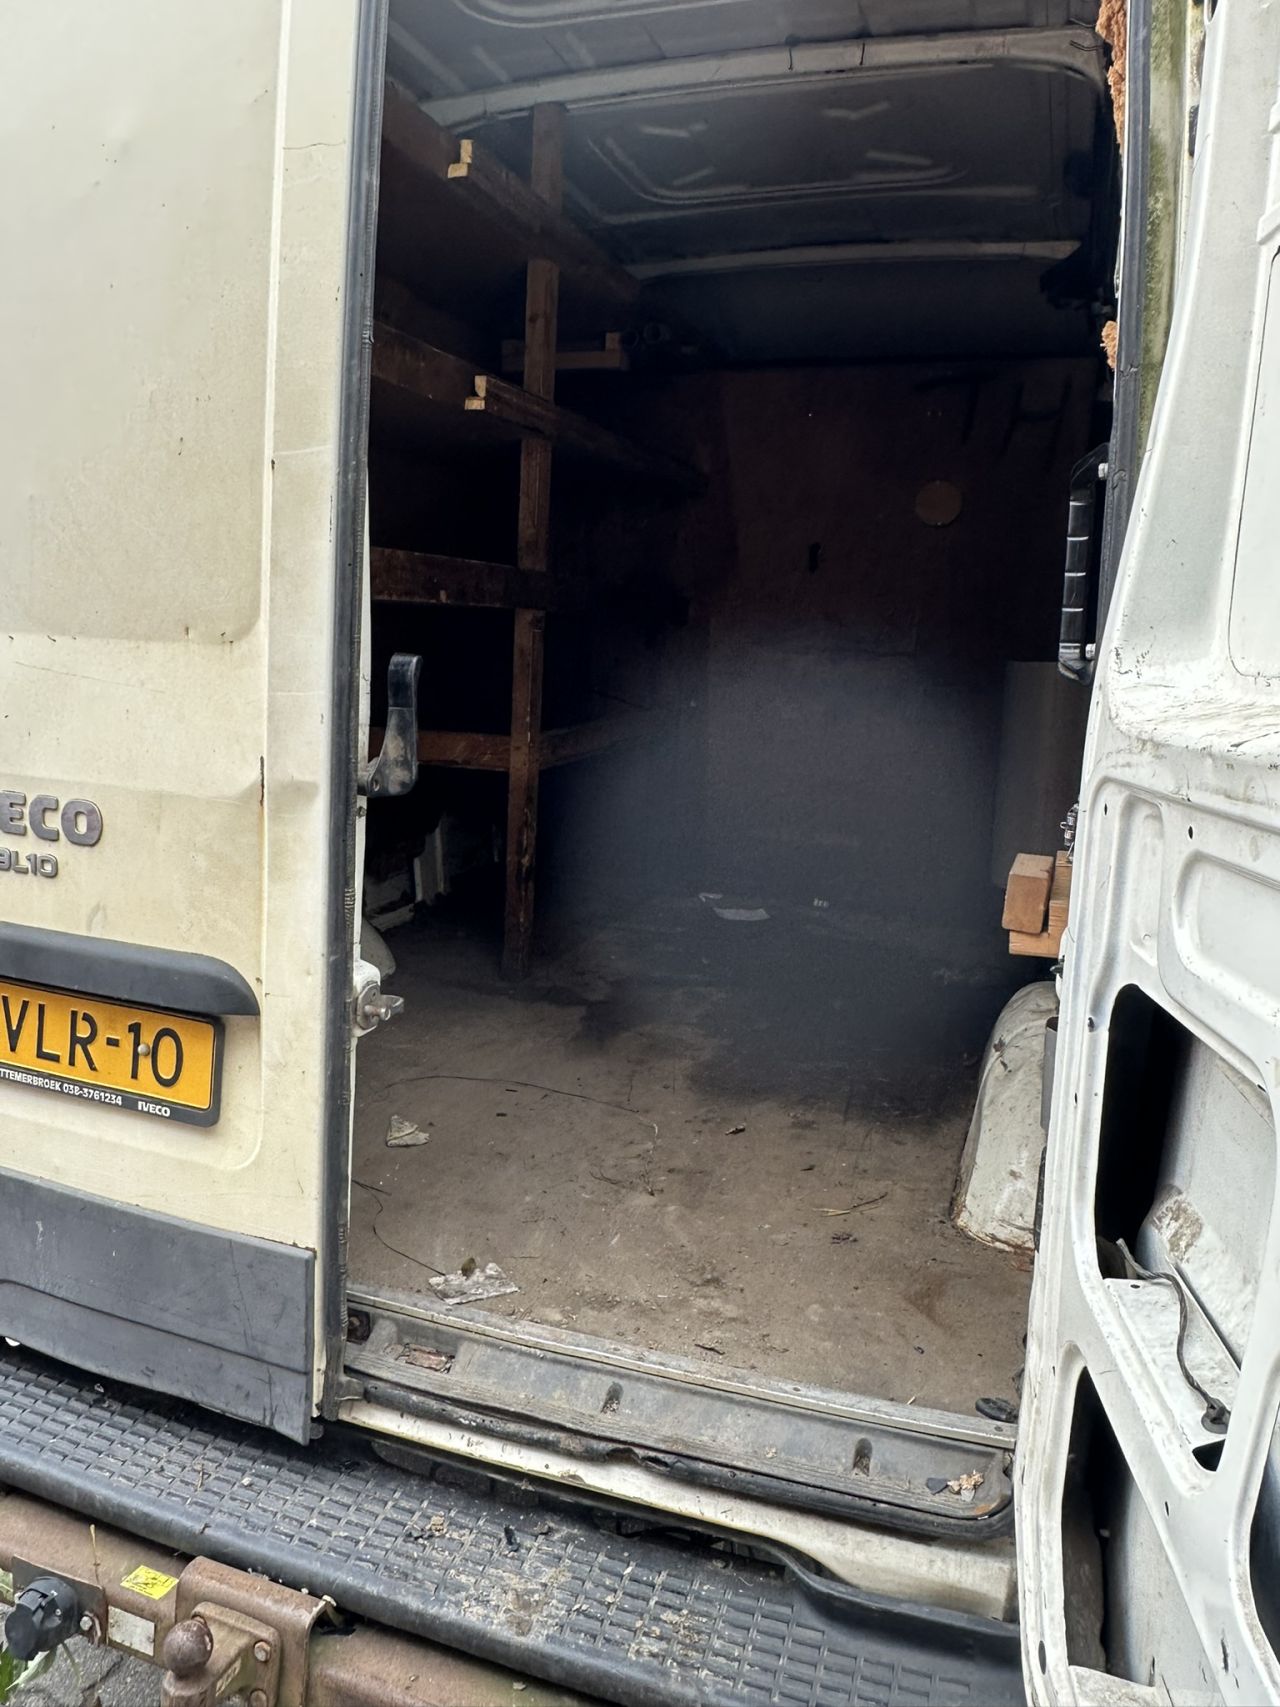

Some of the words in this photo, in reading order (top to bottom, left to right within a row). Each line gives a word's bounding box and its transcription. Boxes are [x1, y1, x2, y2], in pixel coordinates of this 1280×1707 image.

[0, 790, 103, 847] ECO
[2, 995, 183, 1087] VLR-10
[63, 1083, 122, 1106] 038-3761234
[138, 1100, 171, 1117] IVECO
